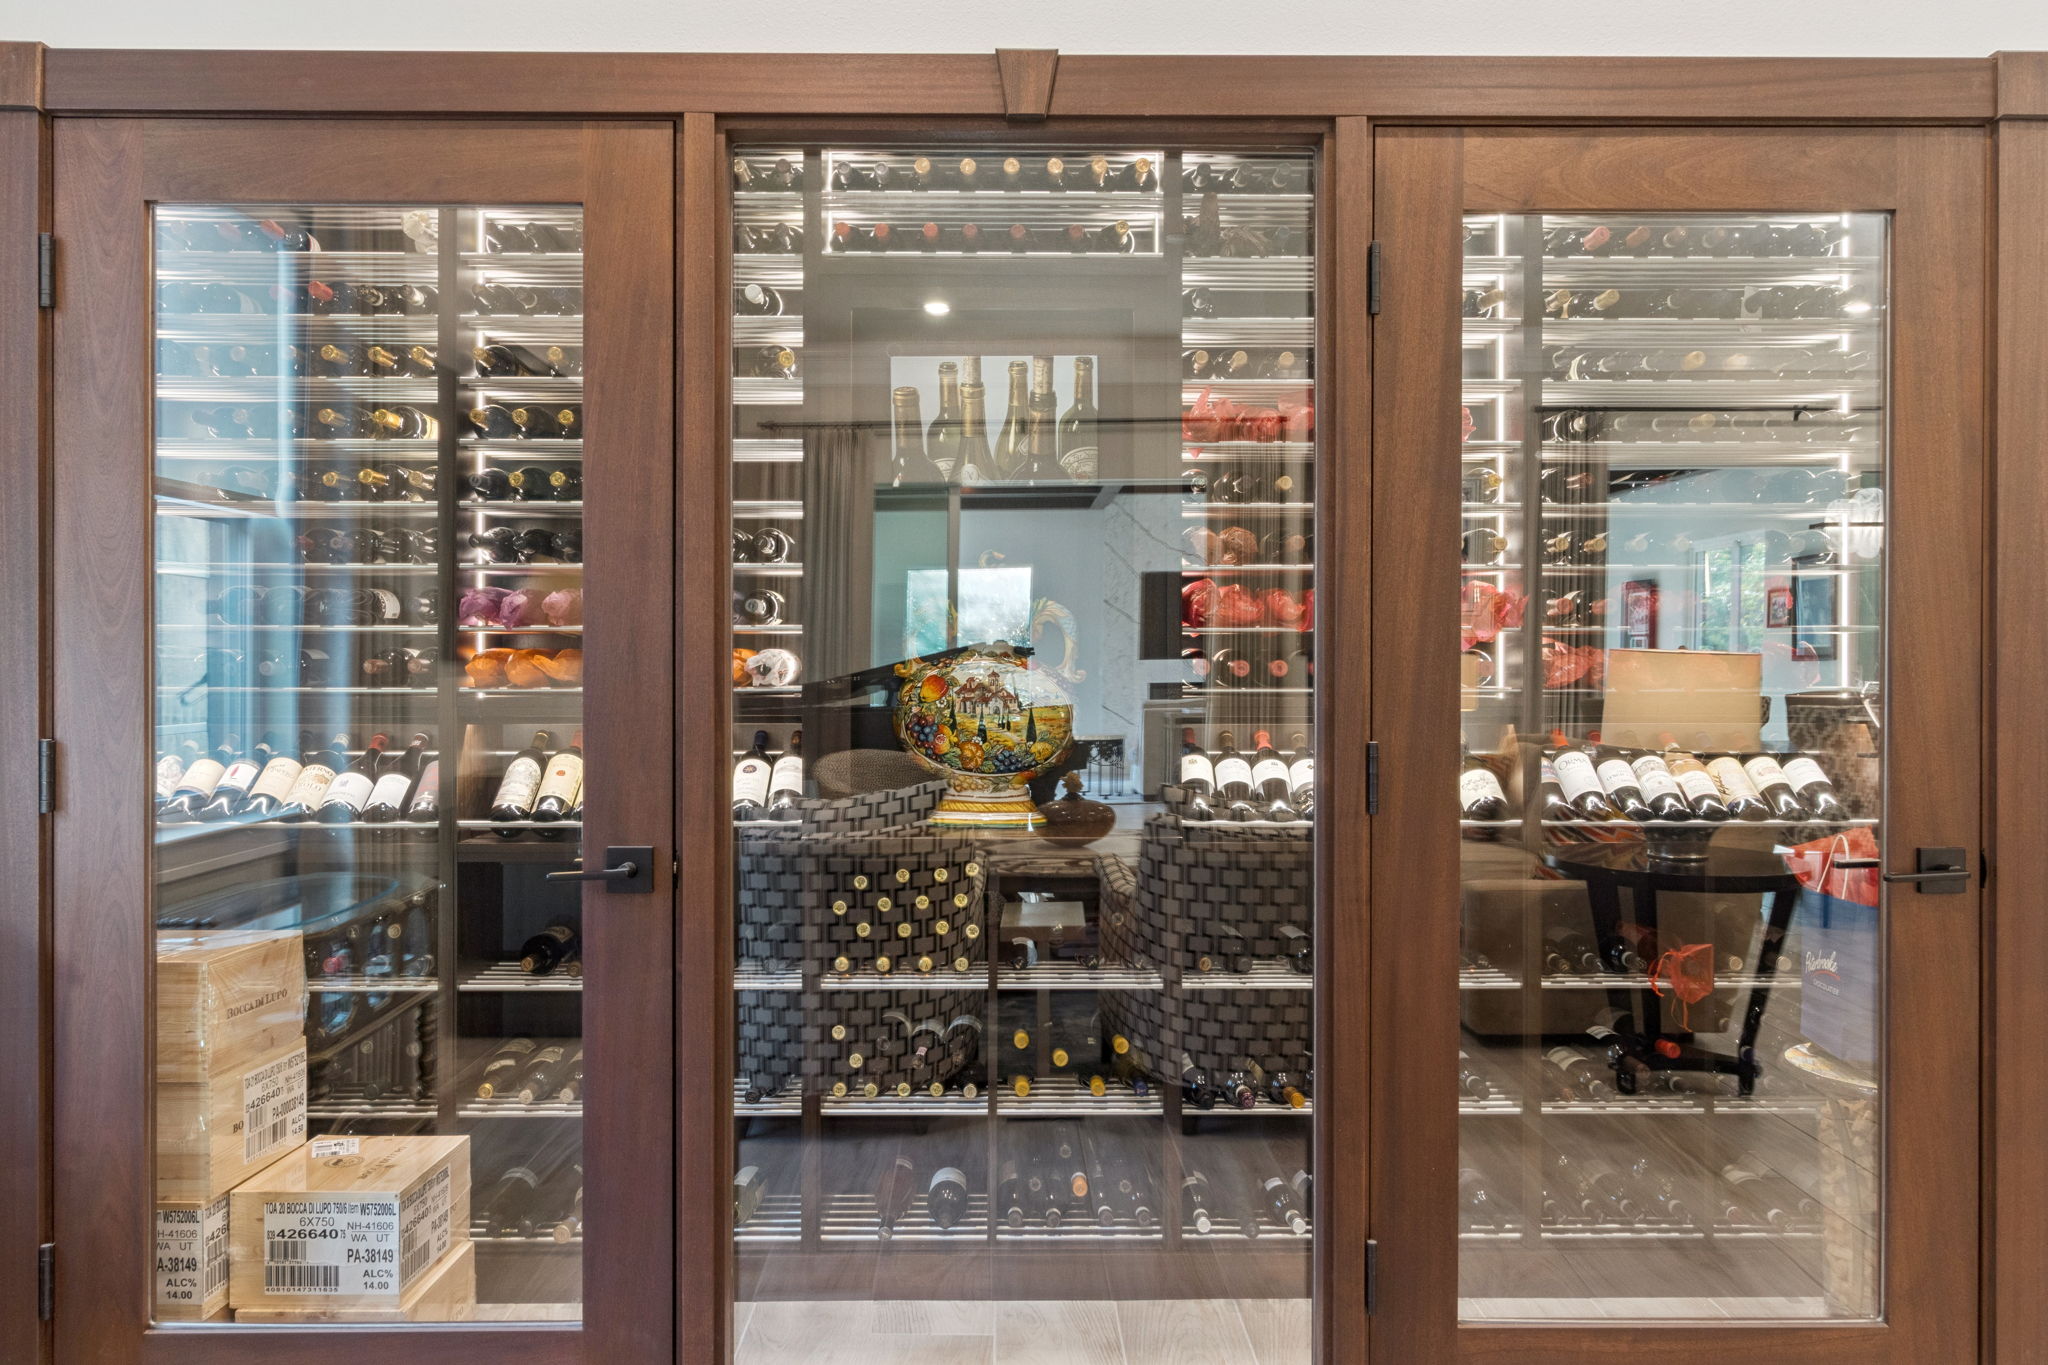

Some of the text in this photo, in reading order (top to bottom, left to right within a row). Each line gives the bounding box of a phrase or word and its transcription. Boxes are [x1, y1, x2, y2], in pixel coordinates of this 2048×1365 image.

[226, 988, 288, 1020] BOCCA DI LUPO
[250, 1087, 280, 1109] 426640
[265, 1202, 277, 1215] TOA
[278, 1203, 286, 1214] 20
[286, 1203, 308, 1215] BOCCA
[308, 1203, 315, 1215] DI
[315, 1203, 332, 1215] LUPO
[360, 1203, 396, 1216] W5752006L
[163, 1210, 200, 1224] W5752006L
[299, 1216, 335, 1227] 6X750
[347, 1222, 394, 1231] NH-41606
[157, 1229, 198, 1239] H-41606
[210, 1223, 228, 1242] 426
[276, 1228, 339, 1239] 426640
[351, 1234, 390, 1242] WA UT
[179, 1242, 193, 1251] UT
[347, 1248, 394, 1263] PA-38149
[157, 1257, 197, 1272] A-38149
[363, 1269, 394, 1278] ALC%
[166, 1278, 197, 1287] ALC%
[363, 1281, 389, 1290] 14.00
[166, 1291, 193, 1300] 14.00
